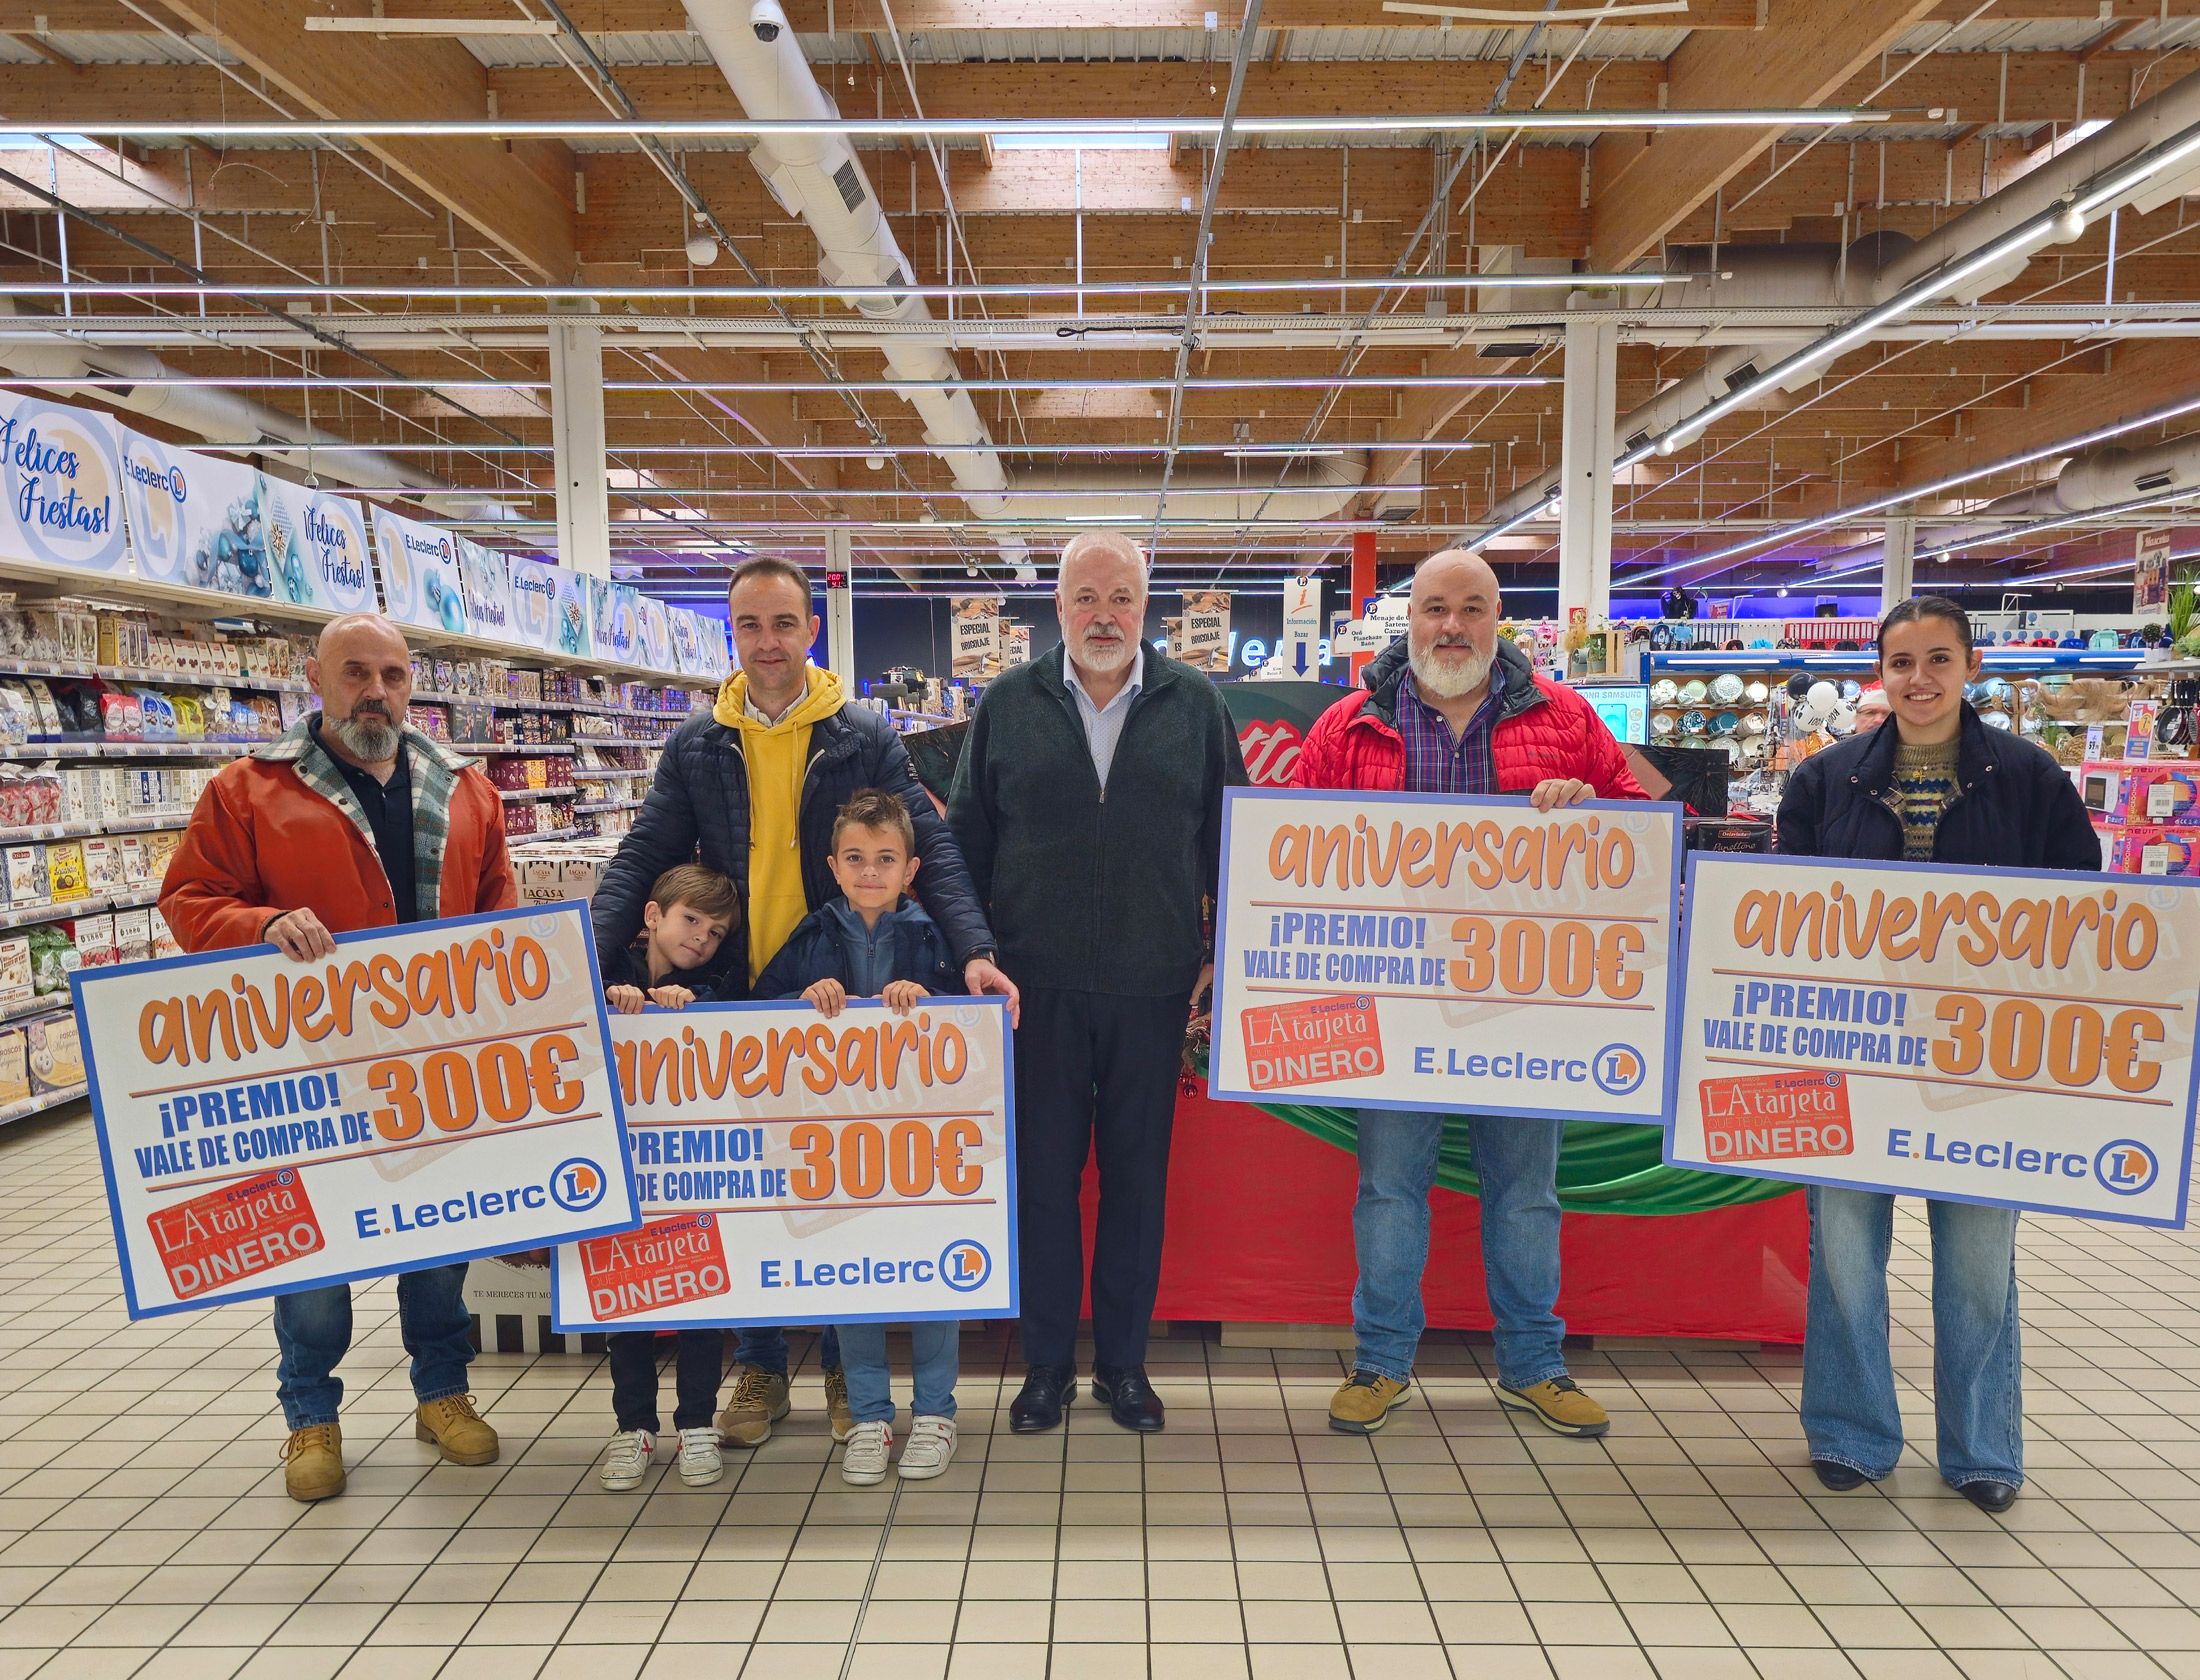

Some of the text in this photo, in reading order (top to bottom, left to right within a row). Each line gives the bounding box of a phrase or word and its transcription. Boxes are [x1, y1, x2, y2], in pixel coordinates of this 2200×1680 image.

[124, 455, 169, 492] E.Leclerc
[20, 473, 109, 534] Fiestas!
[406, 534, 439, 558] E.Leclerc
[322, 549, 365, 588] Fiestas!
[515, 575, 546, 594] E.Leclerc
[960, 623, 990, 635] ESPECIAL
[1191, 617, 1222, 629] ESPECIAL
[1191, 631, 1220, 645] BRICOLAJE
[961, 638, 990, 651] BRICOLAJE
[1269, 814, 1635, 890] aniversario
[523, 888, 564, 899] LACASA
[1270, 912, 1426, 949] ¡PREMIO!
[1733, 881, 2159, 971] aniversario
[1244, 950, 1445, 986] VALE DE COMPRA DE
[1451, 917, 1645, 1000] 300€
[139, 928, 550, 1067] aniversario
[1733, 982, 1907, 1027] ¡PREMIO!
[1246, 1012, 1367, 1046] LA tarjeta
[1704, 1019, 1927, 1067] VALE DE COMPRA DE
[1932, 994, 2165, 1093] 300€
[1251, 1046, 1378, 1085] DINERO
[1414, 1047, 1587, 1083] E.Leclerc
[159, 1073, 339, 1138] ¡PREMIO!
[367, 1034, 584, 1142] 300€
[1704, 1084, 1836, 1118] LA tarjeta
[135, 1111, 373, 1178] VALE DE COMPRA DE
[790, 1118, 984, 1200] 300€
[1709, 1124, 1848, 1156] DINERO
[1887, 1129, 2088, 1179] E.Leclerc
[663, 1168, 751, 1202] COMPRA
[761, 1168, 787, 1198] DE
[154, 1190, 296, 1254] LA tarjeta
[355, 1182, 546, 1240] E.Leclerc
[171, 1222, 317, 1294] DINERO
[584, 1232, 710, 1276] LA tarjeta
[761, 1258, 934, 1288] E.Leclerc
[593, 1265, 724, 1315] DINERO
